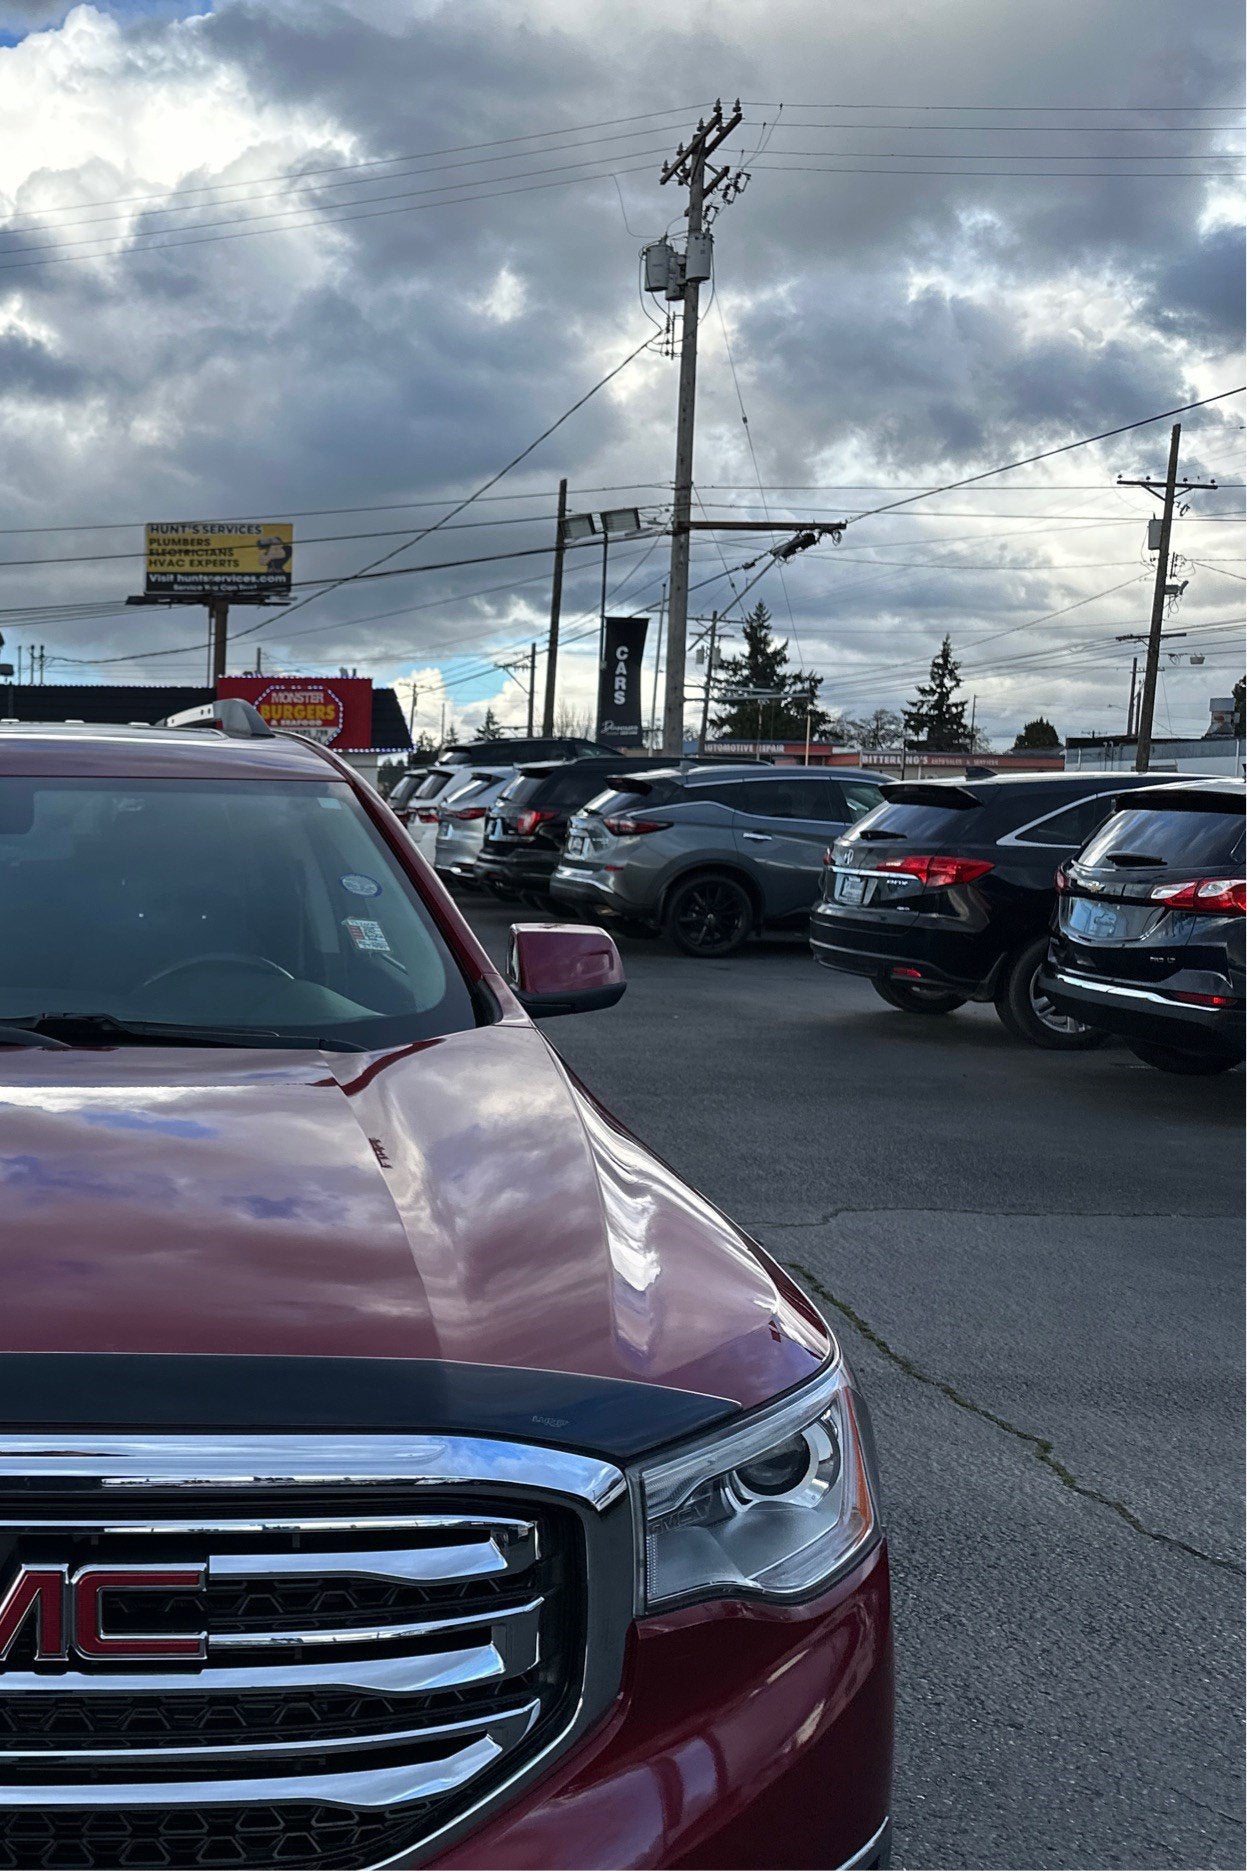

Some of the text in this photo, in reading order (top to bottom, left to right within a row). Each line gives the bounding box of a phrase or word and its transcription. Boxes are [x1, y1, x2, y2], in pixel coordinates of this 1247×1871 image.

[150, 524, 262, 535] HUNT'S SERVICES
[149, 538, 211, 547] PLUMBERS
[149, 559, 240, 568] HVAC EXPERTS
[149, 573, 175, 583] Visit
[614, 645, 629, 706] CARS
[271, 691, 325, 704] MONSTER
[260, 704, 336, 720] BURGERS
